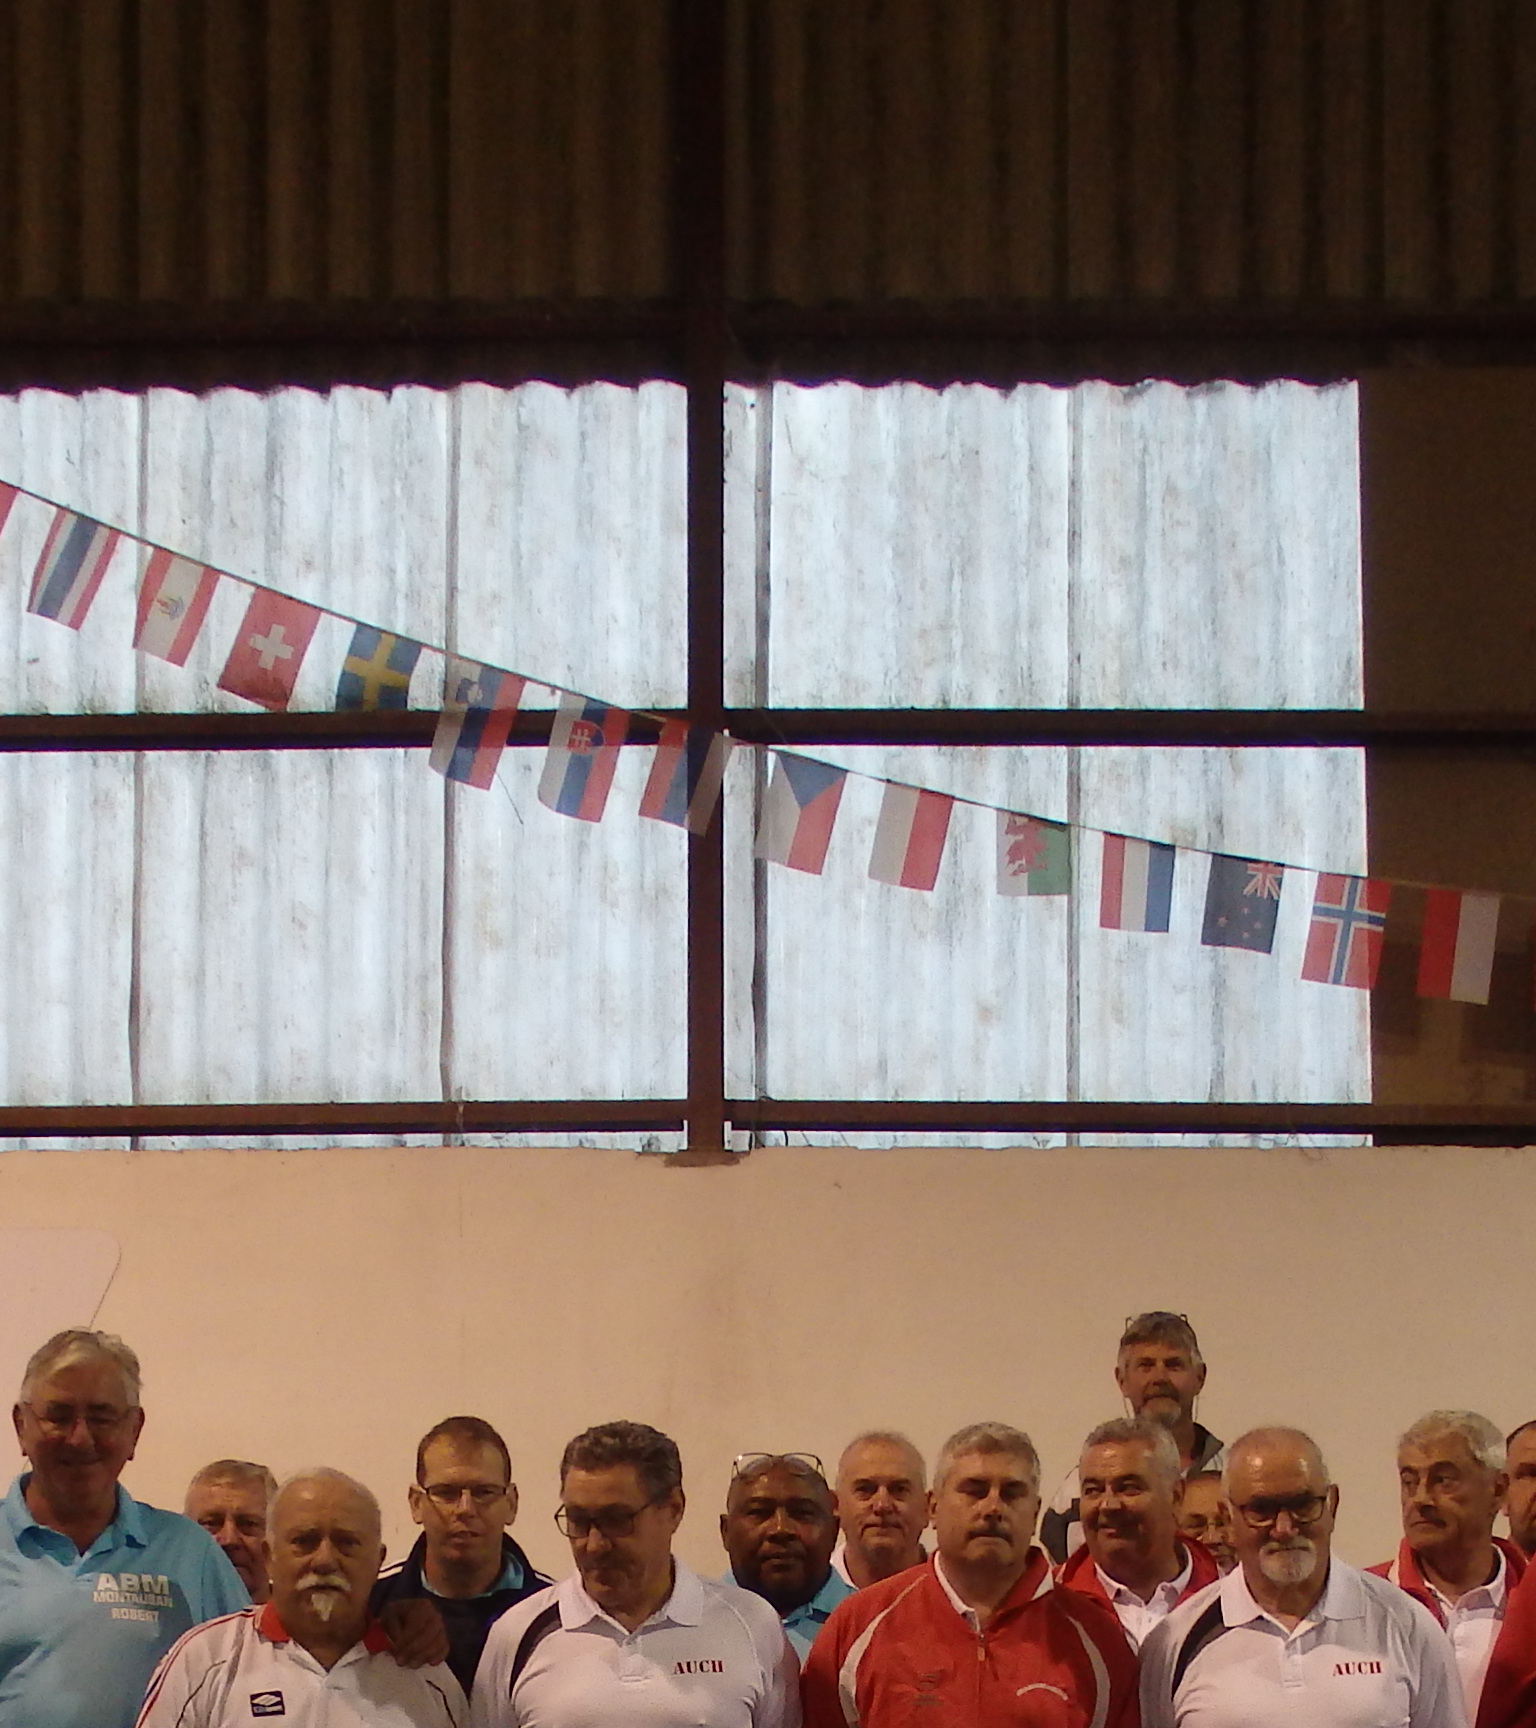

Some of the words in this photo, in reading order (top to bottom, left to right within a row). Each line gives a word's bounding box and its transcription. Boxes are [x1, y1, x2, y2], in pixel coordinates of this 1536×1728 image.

[96, 1572, 170, 1595] ABM
[673, 1660, 724, 1675] AUCH
[1332, 1661, 1382, 1677] AUCH
